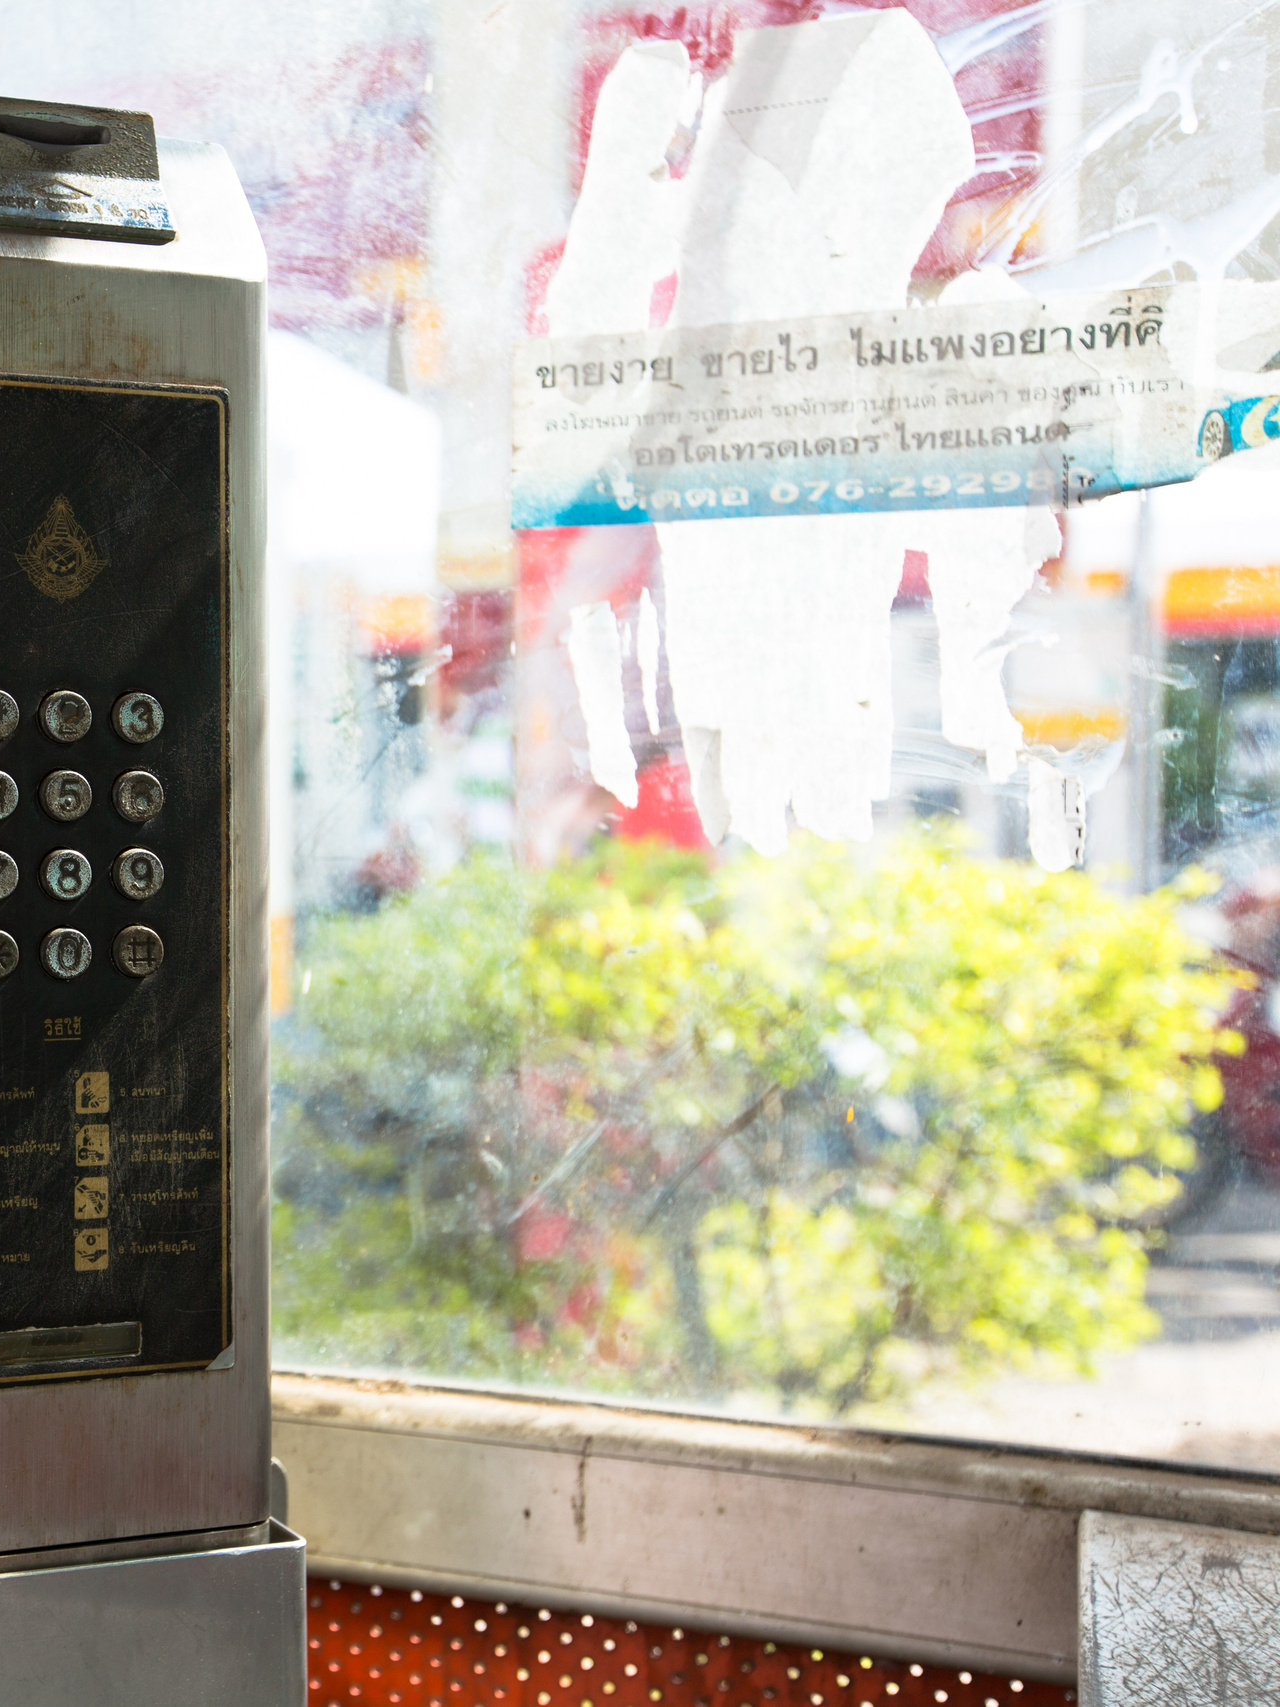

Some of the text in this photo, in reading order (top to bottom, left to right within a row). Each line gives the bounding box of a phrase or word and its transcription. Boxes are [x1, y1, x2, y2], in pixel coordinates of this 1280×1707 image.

[535, 336, 675, 389] ขายง่าย
[699, 332, 819, 378] ขายไว
[129, 700, 154, 736] 3
[59, 778, 82, 814] 5
[57, 857, 82, 894] 8
[130, 856, 154, 891] 9
[57, 935, 82, 971] 0
[43, 1015, 82, 1036] วิธีใช้
